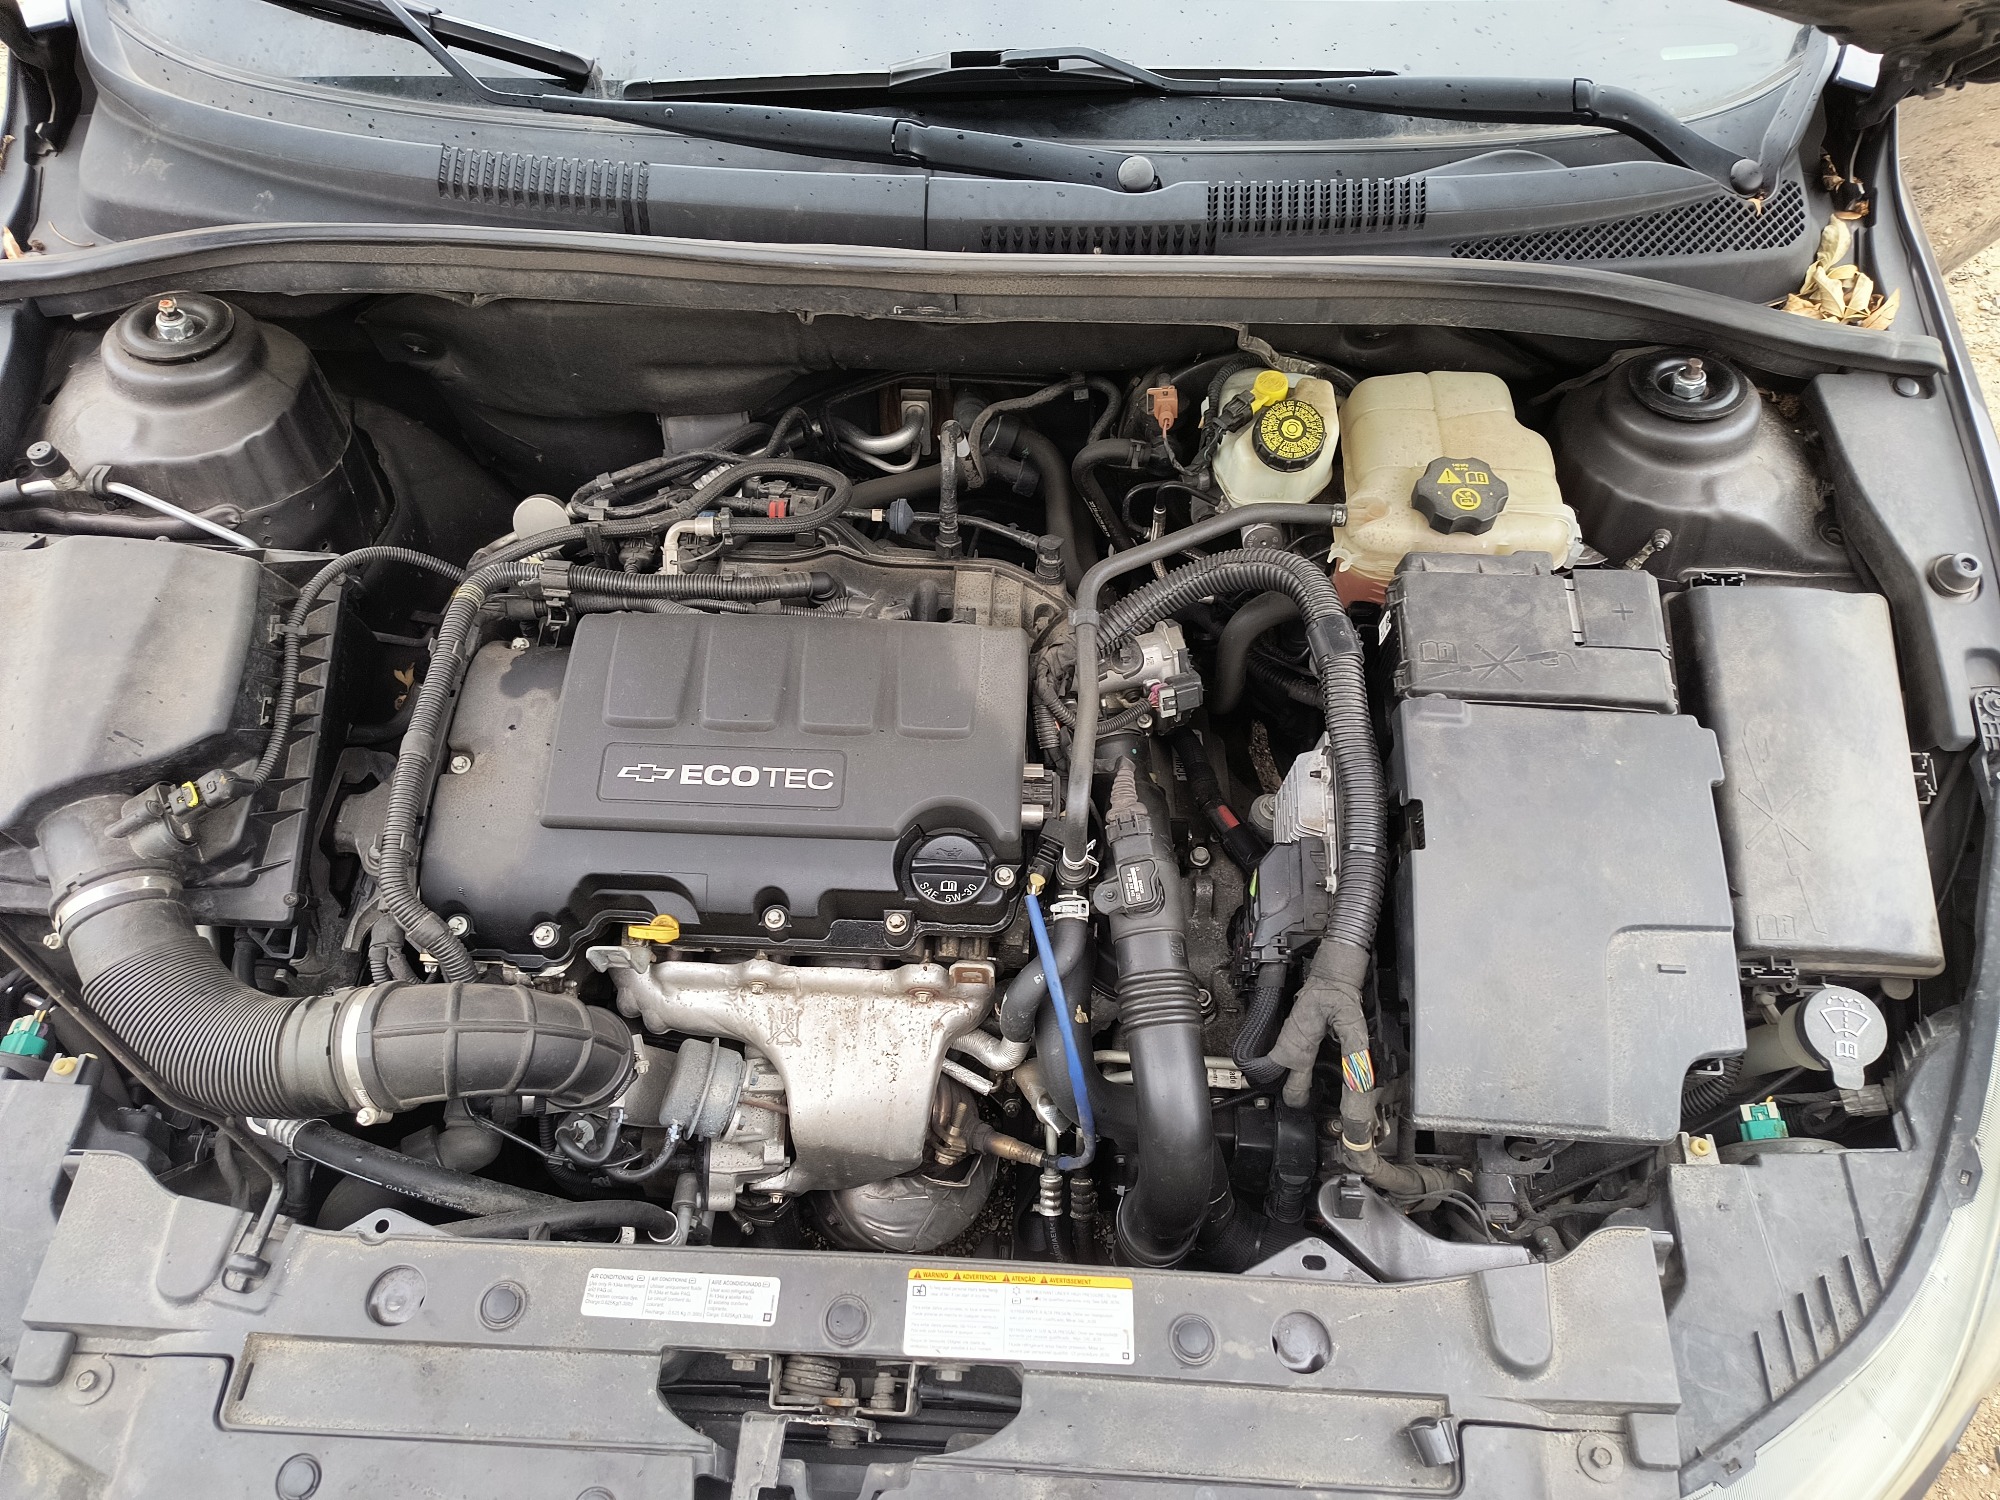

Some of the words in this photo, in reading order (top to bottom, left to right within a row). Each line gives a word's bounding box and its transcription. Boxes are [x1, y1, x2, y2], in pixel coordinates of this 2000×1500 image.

[680, 764, 834, 790] ECOTEC
[920, 882, 939, 900] SAE
[945, 883, 977, 903] 5W-30
[386, 1184, 423, 1198] GALAXY
[1049, 1277, 1091, 1285] AVERTISSEMENT
